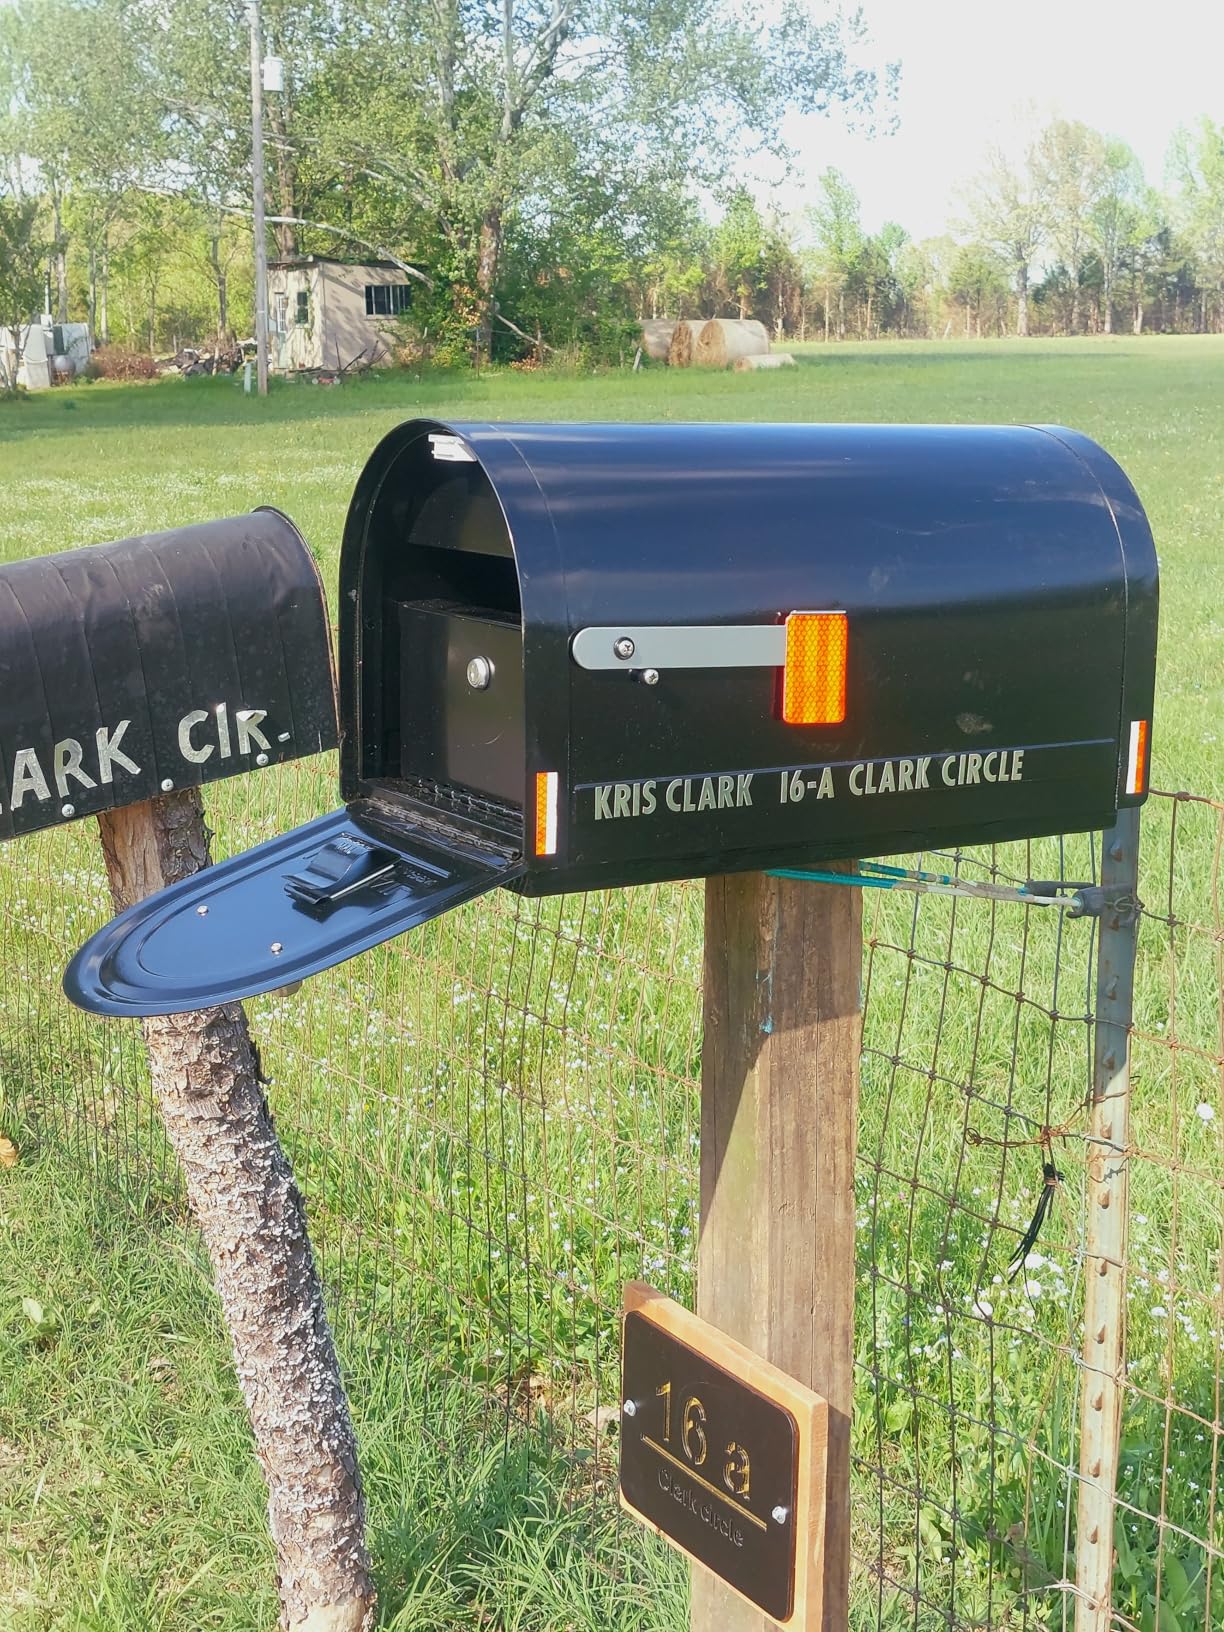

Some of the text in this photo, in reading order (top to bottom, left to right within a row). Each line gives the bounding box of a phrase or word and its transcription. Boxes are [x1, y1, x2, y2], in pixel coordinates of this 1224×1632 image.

[0, 719, 142, 815] ARK
[593, 749, 1025, 820] KRIS CLARK 16-A CLARK CIRCLE
[658, 1468, 698, 1515] Clark
